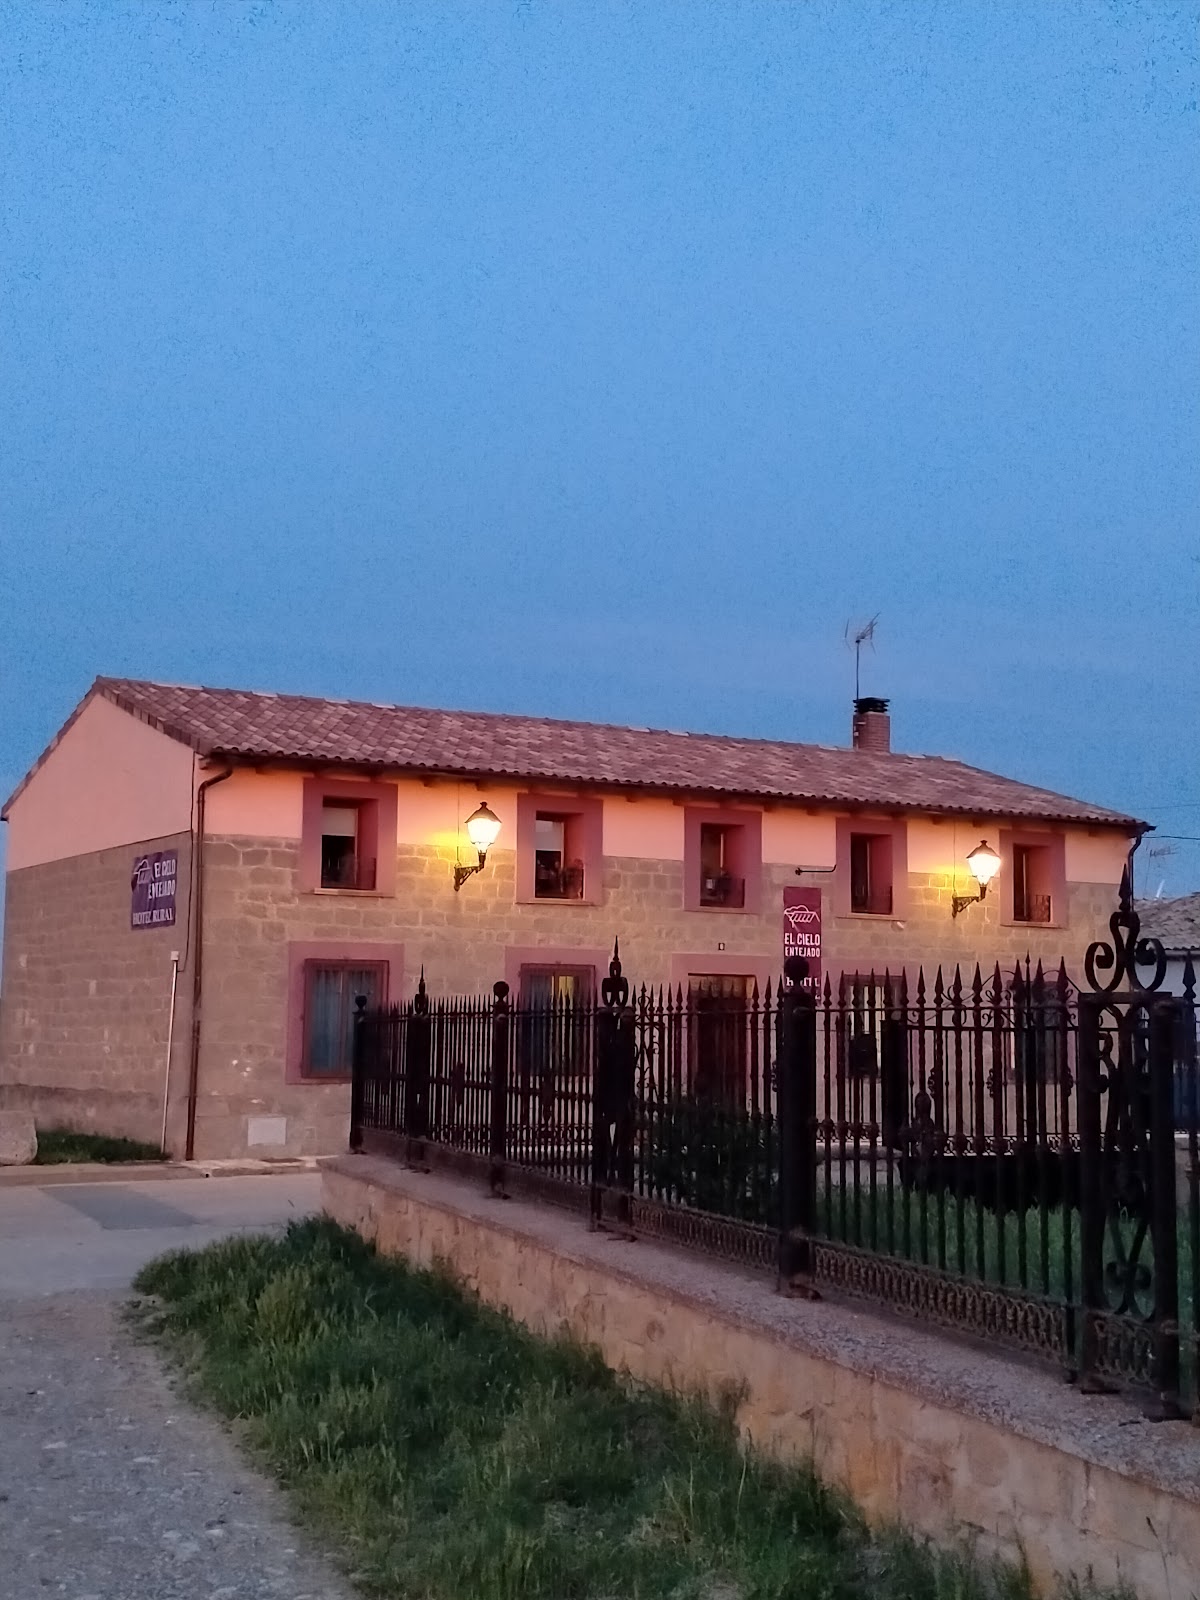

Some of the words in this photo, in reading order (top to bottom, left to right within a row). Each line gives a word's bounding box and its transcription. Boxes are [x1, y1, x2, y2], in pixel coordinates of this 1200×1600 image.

[133, 911, 151, 924] HOTEL
[785, 933, 795, 944] EL
[797, 933, 820, 946] CIELO
[785, 946, 820, 957] ENTEJADO
